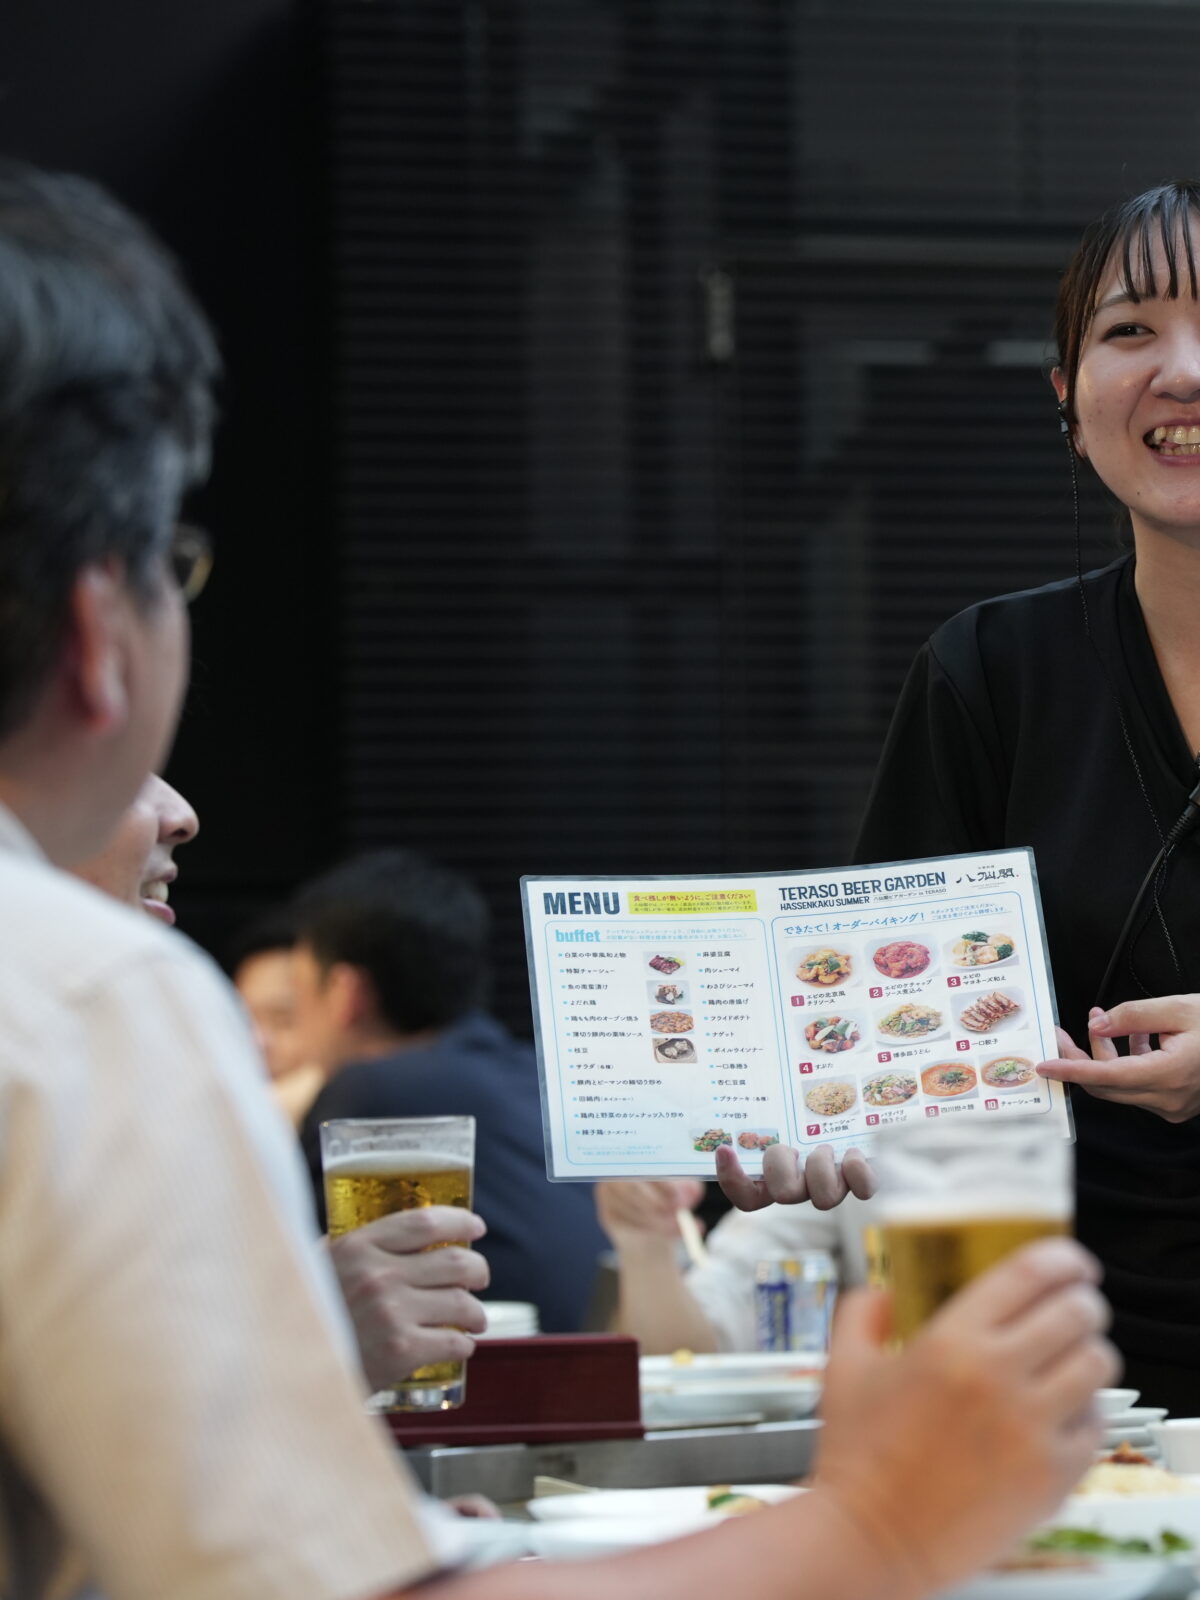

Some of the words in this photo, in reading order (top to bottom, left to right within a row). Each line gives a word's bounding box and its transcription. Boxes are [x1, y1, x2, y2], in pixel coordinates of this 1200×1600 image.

[779, 883, 838, 901] TERASO
[841, 879, 882, 896] BEER
[884, 871, 946, 892] GARDEN
[925, 888, 947, 896] TERASO
[543, 892, 620, 915] MENU
[780, 898, 835, 911] HASSENKAKU
[835, 896, 870, 908] SUMMER
[555, 929, 601, 943] buffet
